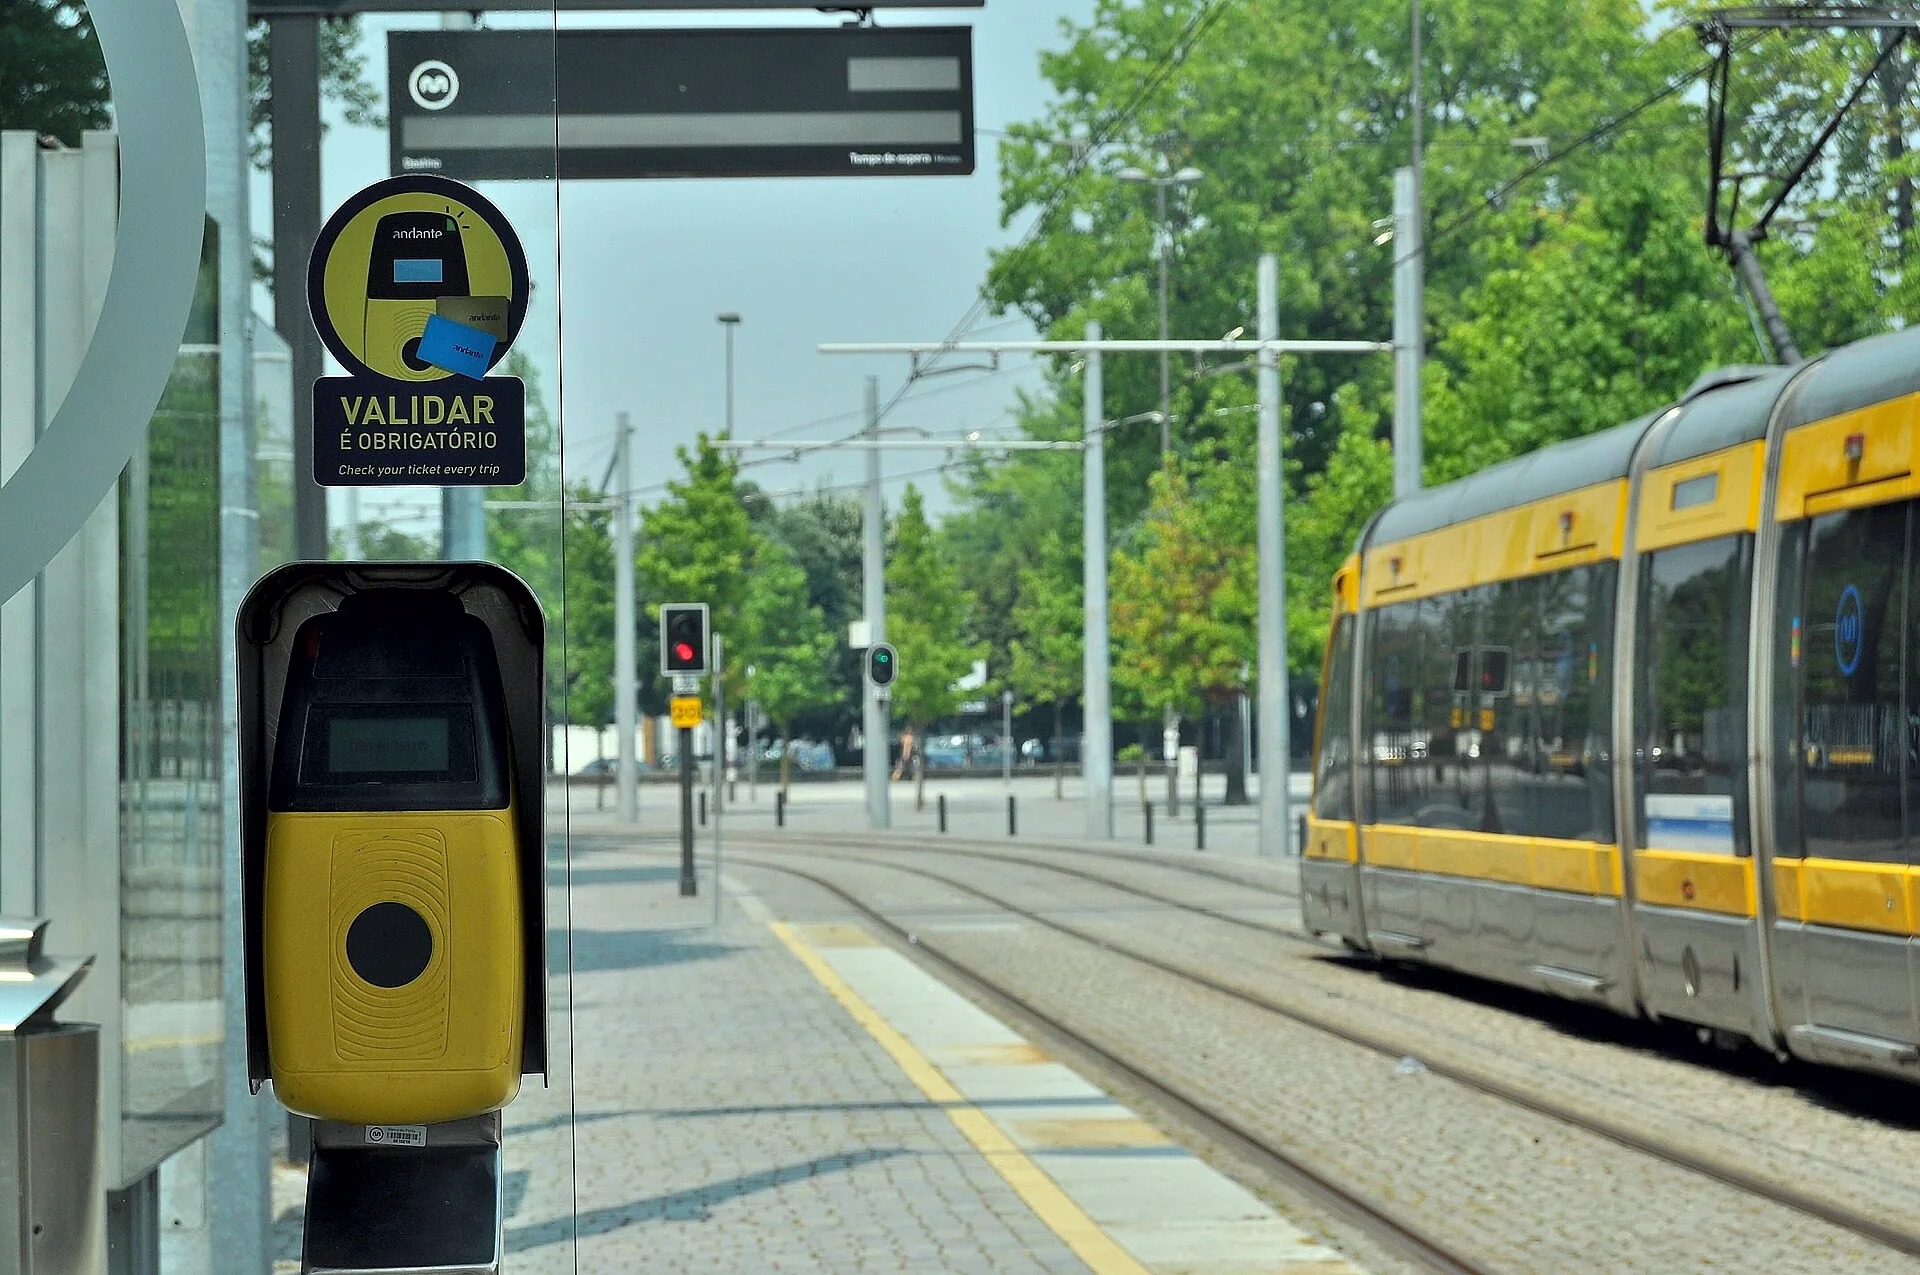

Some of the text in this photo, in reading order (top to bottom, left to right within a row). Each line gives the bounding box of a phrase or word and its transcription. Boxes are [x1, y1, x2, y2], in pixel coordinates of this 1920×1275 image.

[393, 227, 443, 239] andante
[469, 313, 501, 321] andante
[452, 343, 484, 359] andante
[340, 396, 495, 425] VALIDAR
[340, 427, 498, 450] É OBRIGATÓRIO
[338, 463, 500, 477] Check your ticket every trip
